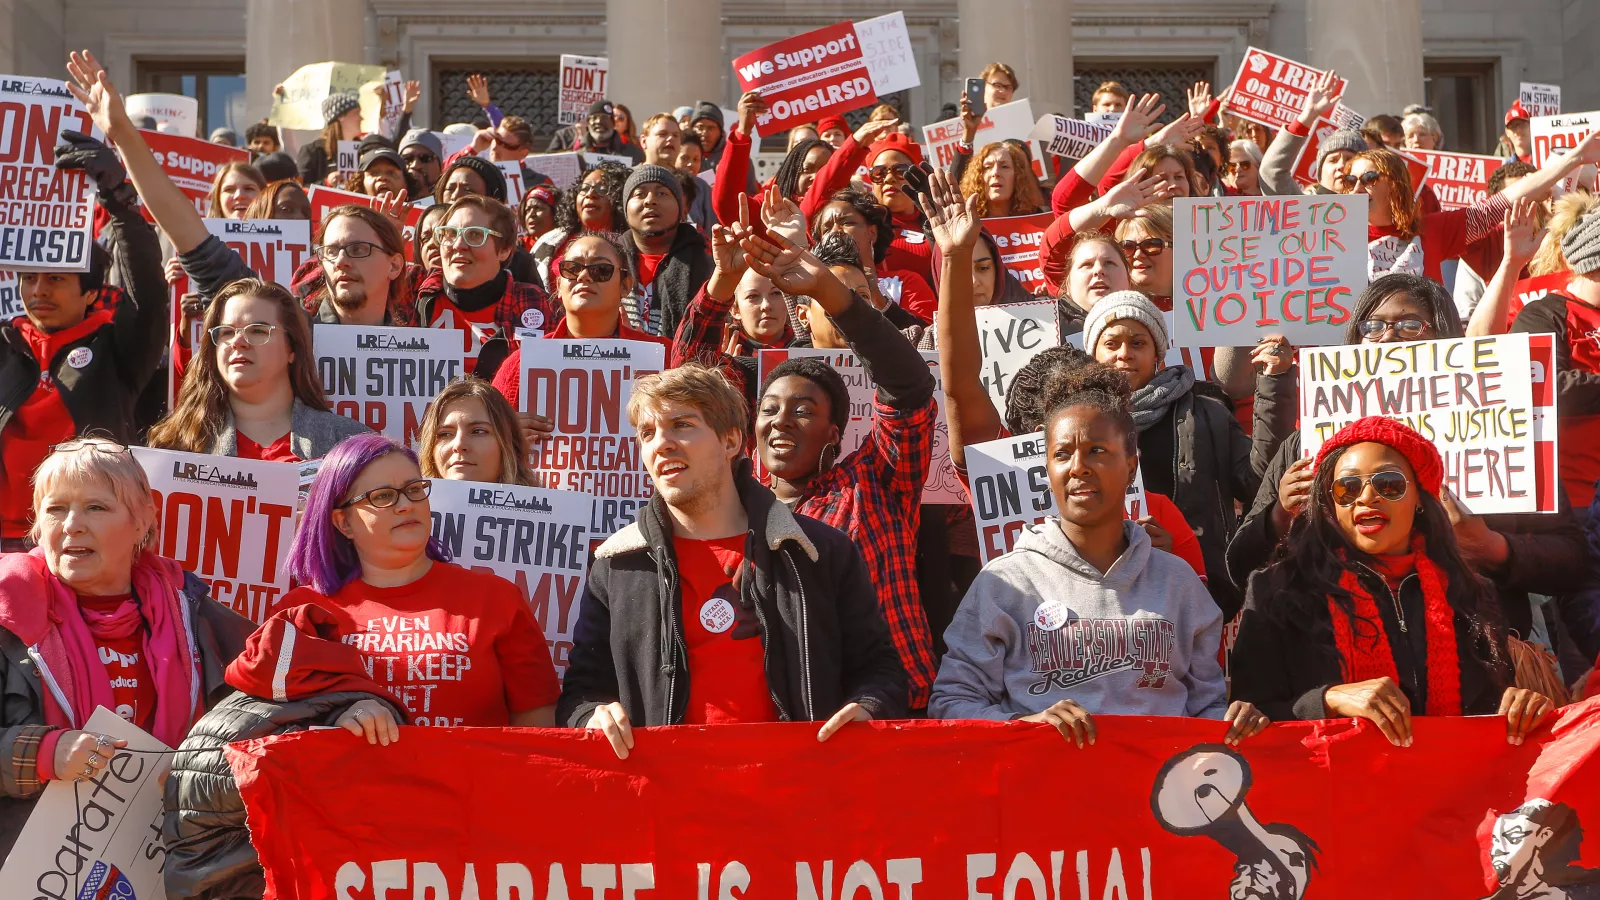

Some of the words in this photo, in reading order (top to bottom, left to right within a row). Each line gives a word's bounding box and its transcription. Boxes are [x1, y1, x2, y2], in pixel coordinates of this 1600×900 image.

[739, 60, 774, 82] We
[775, 33, 855, 68] Support
[798, 70, 828, 82] educators
[840, 60, 862, 70] schools
[2, 80, 43, 95] LREA
[563, 66, 607, 92] DON'T
[1246, 78, 1270, 98] On
[1269, 59, 1318, 93] LRE
[1232, 92, 1250, 108] for
[1251, 98, 1274, 117] OUR
[1521, 92, 1532, 102] ON
[1534, 92, 1559, 105] STRIKE
[340, 152, 354, 168] ON
[936, 141, 960, 167] FA
[1426, 154, 1486, 183] LREA
[225, 223, 258, 233] LREA
[1192, 202, 1234, 234] IT'S
[1238, 200, 1300, 235] TIME
[1308, 202, 1347, 225] TO
[0, 227, 85, 264] ELRSD
[992, 234, 1008, 248] e
[1192, 236, 1260, 265] USE
[1279, 229, 1347, 255] OUR
[1183, 256, 1340, 296] OUTSIDE
[1186, 286, 1352, 332] VOICES
[1518, 288, 1558, 306] W
[357, 334, 398, 348] LREA
[563, 344, 602, 358] LREA
[1309, 338, 1500, 381] INJUSTICE
[318, 357, 356, 396] ON
[366, 358, 460, 397] STRIKE
[527, 365, 659, 435] DON'
[1313, 372, 1506, 418] ANYWHERE
[326, 401, 387, 435] OR
[1445, 405, 1527, 443] JUSTICE
[529, 435, 648, 472] SEGREGAT
[173, 461, 221, 481] LREA
[567, 472, 654, 498] SCHOOLS
[468, 488, 516, 506] LREA
[974, 471, 1021, 521] ON
[591, 499, 649, 533] LRS
[474, 515, 586, 570] STRIKE
[983, 517, 1046, 561] FO
[200, 577, 281, 626] GATE
[704, 600, 723, 617] STAND
[712, 606, 725, 619] WITH
[718, 610, 728, 620] THE
[367, 616, 430, 632] EVEN
[1026, 618, 1128, 672] HENDERSON
[1132, 618, 1175, 670] STATE
[407, 654, 472, 681] KEEP
[1027, 653, 1136, 697] Reddies
[33, 753, 144, 900] parate
